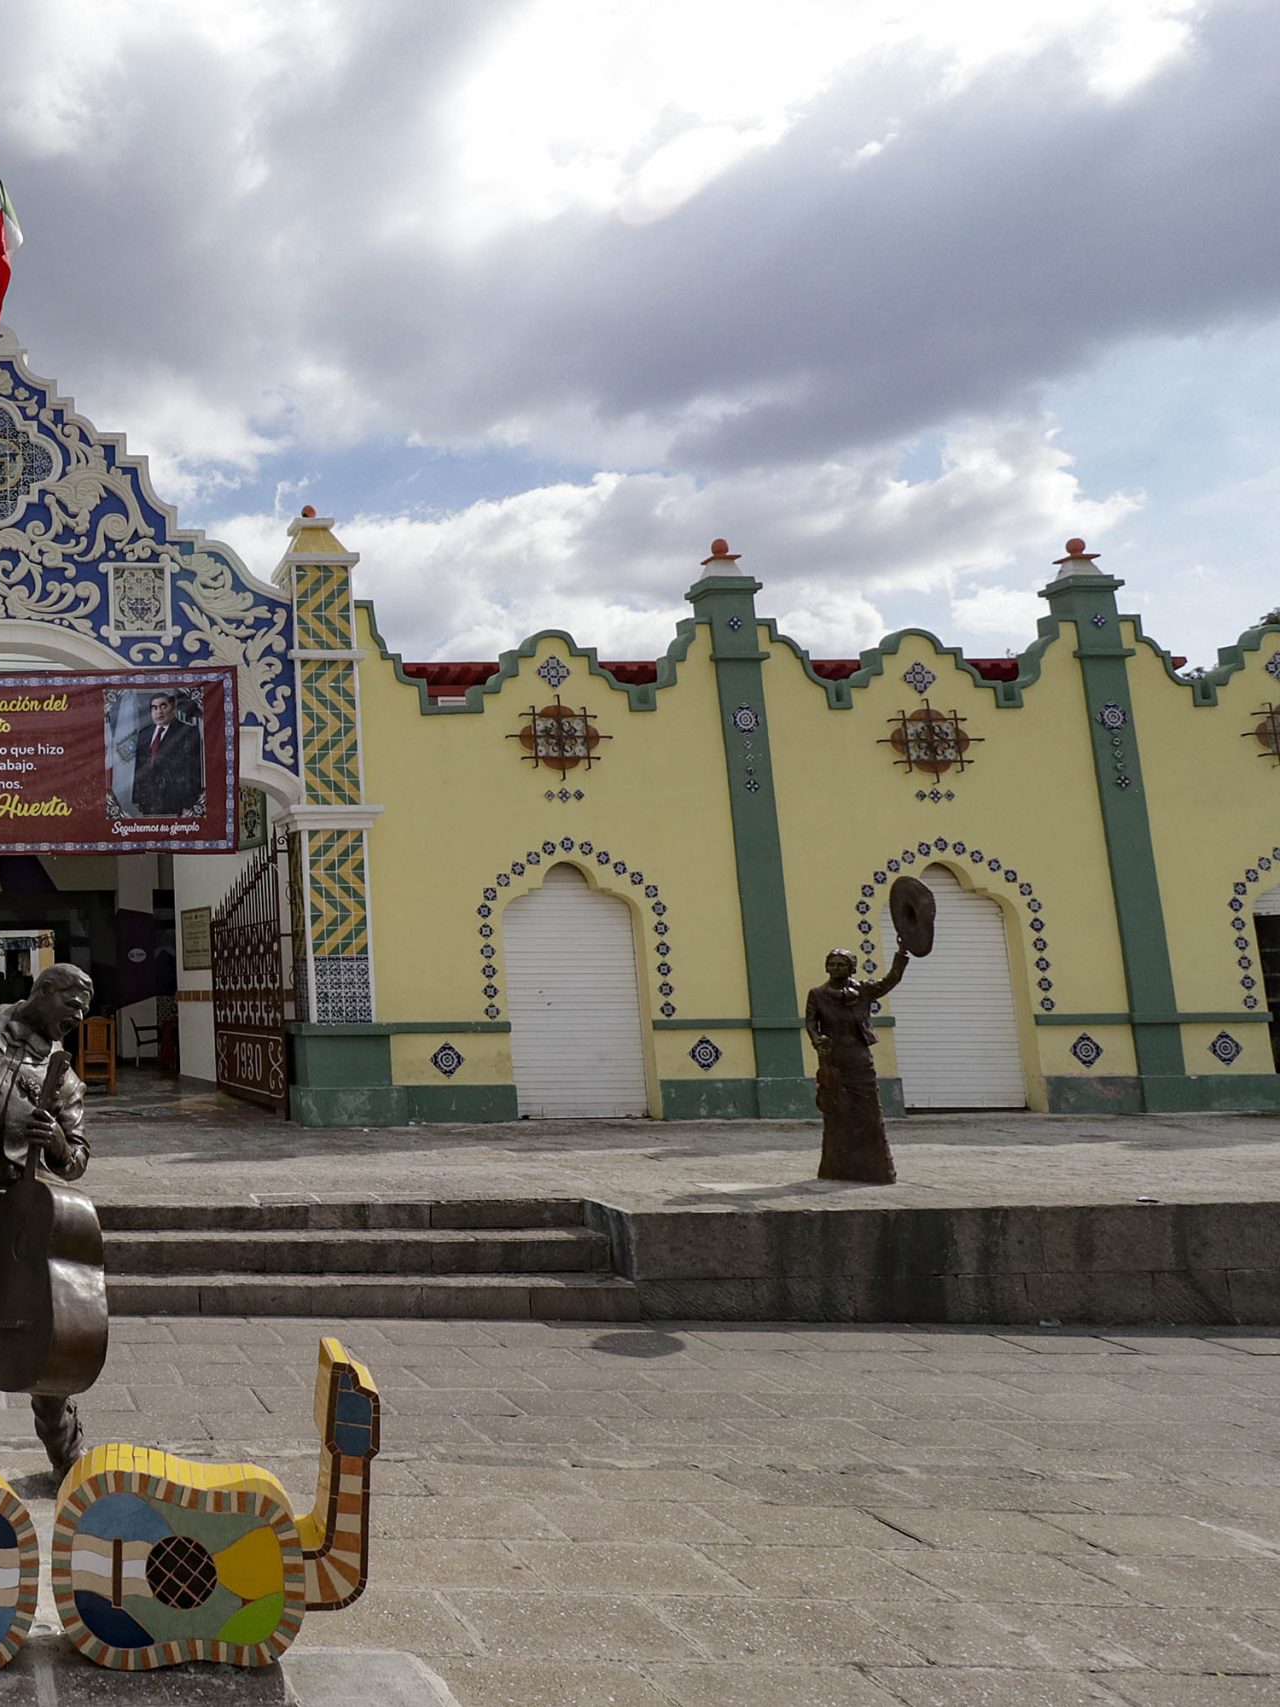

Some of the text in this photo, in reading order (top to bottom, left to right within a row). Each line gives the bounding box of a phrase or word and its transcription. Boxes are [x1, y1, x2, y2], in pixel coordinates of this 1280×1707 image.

[43, 693, 68, 711] del
[10, 746, 35, 757] que
[38, 743, 64, 755] hizo
[111, 821, 200, 836] Seguiremos su ejemplo
[233, 1041, 263, 1081] 1930
